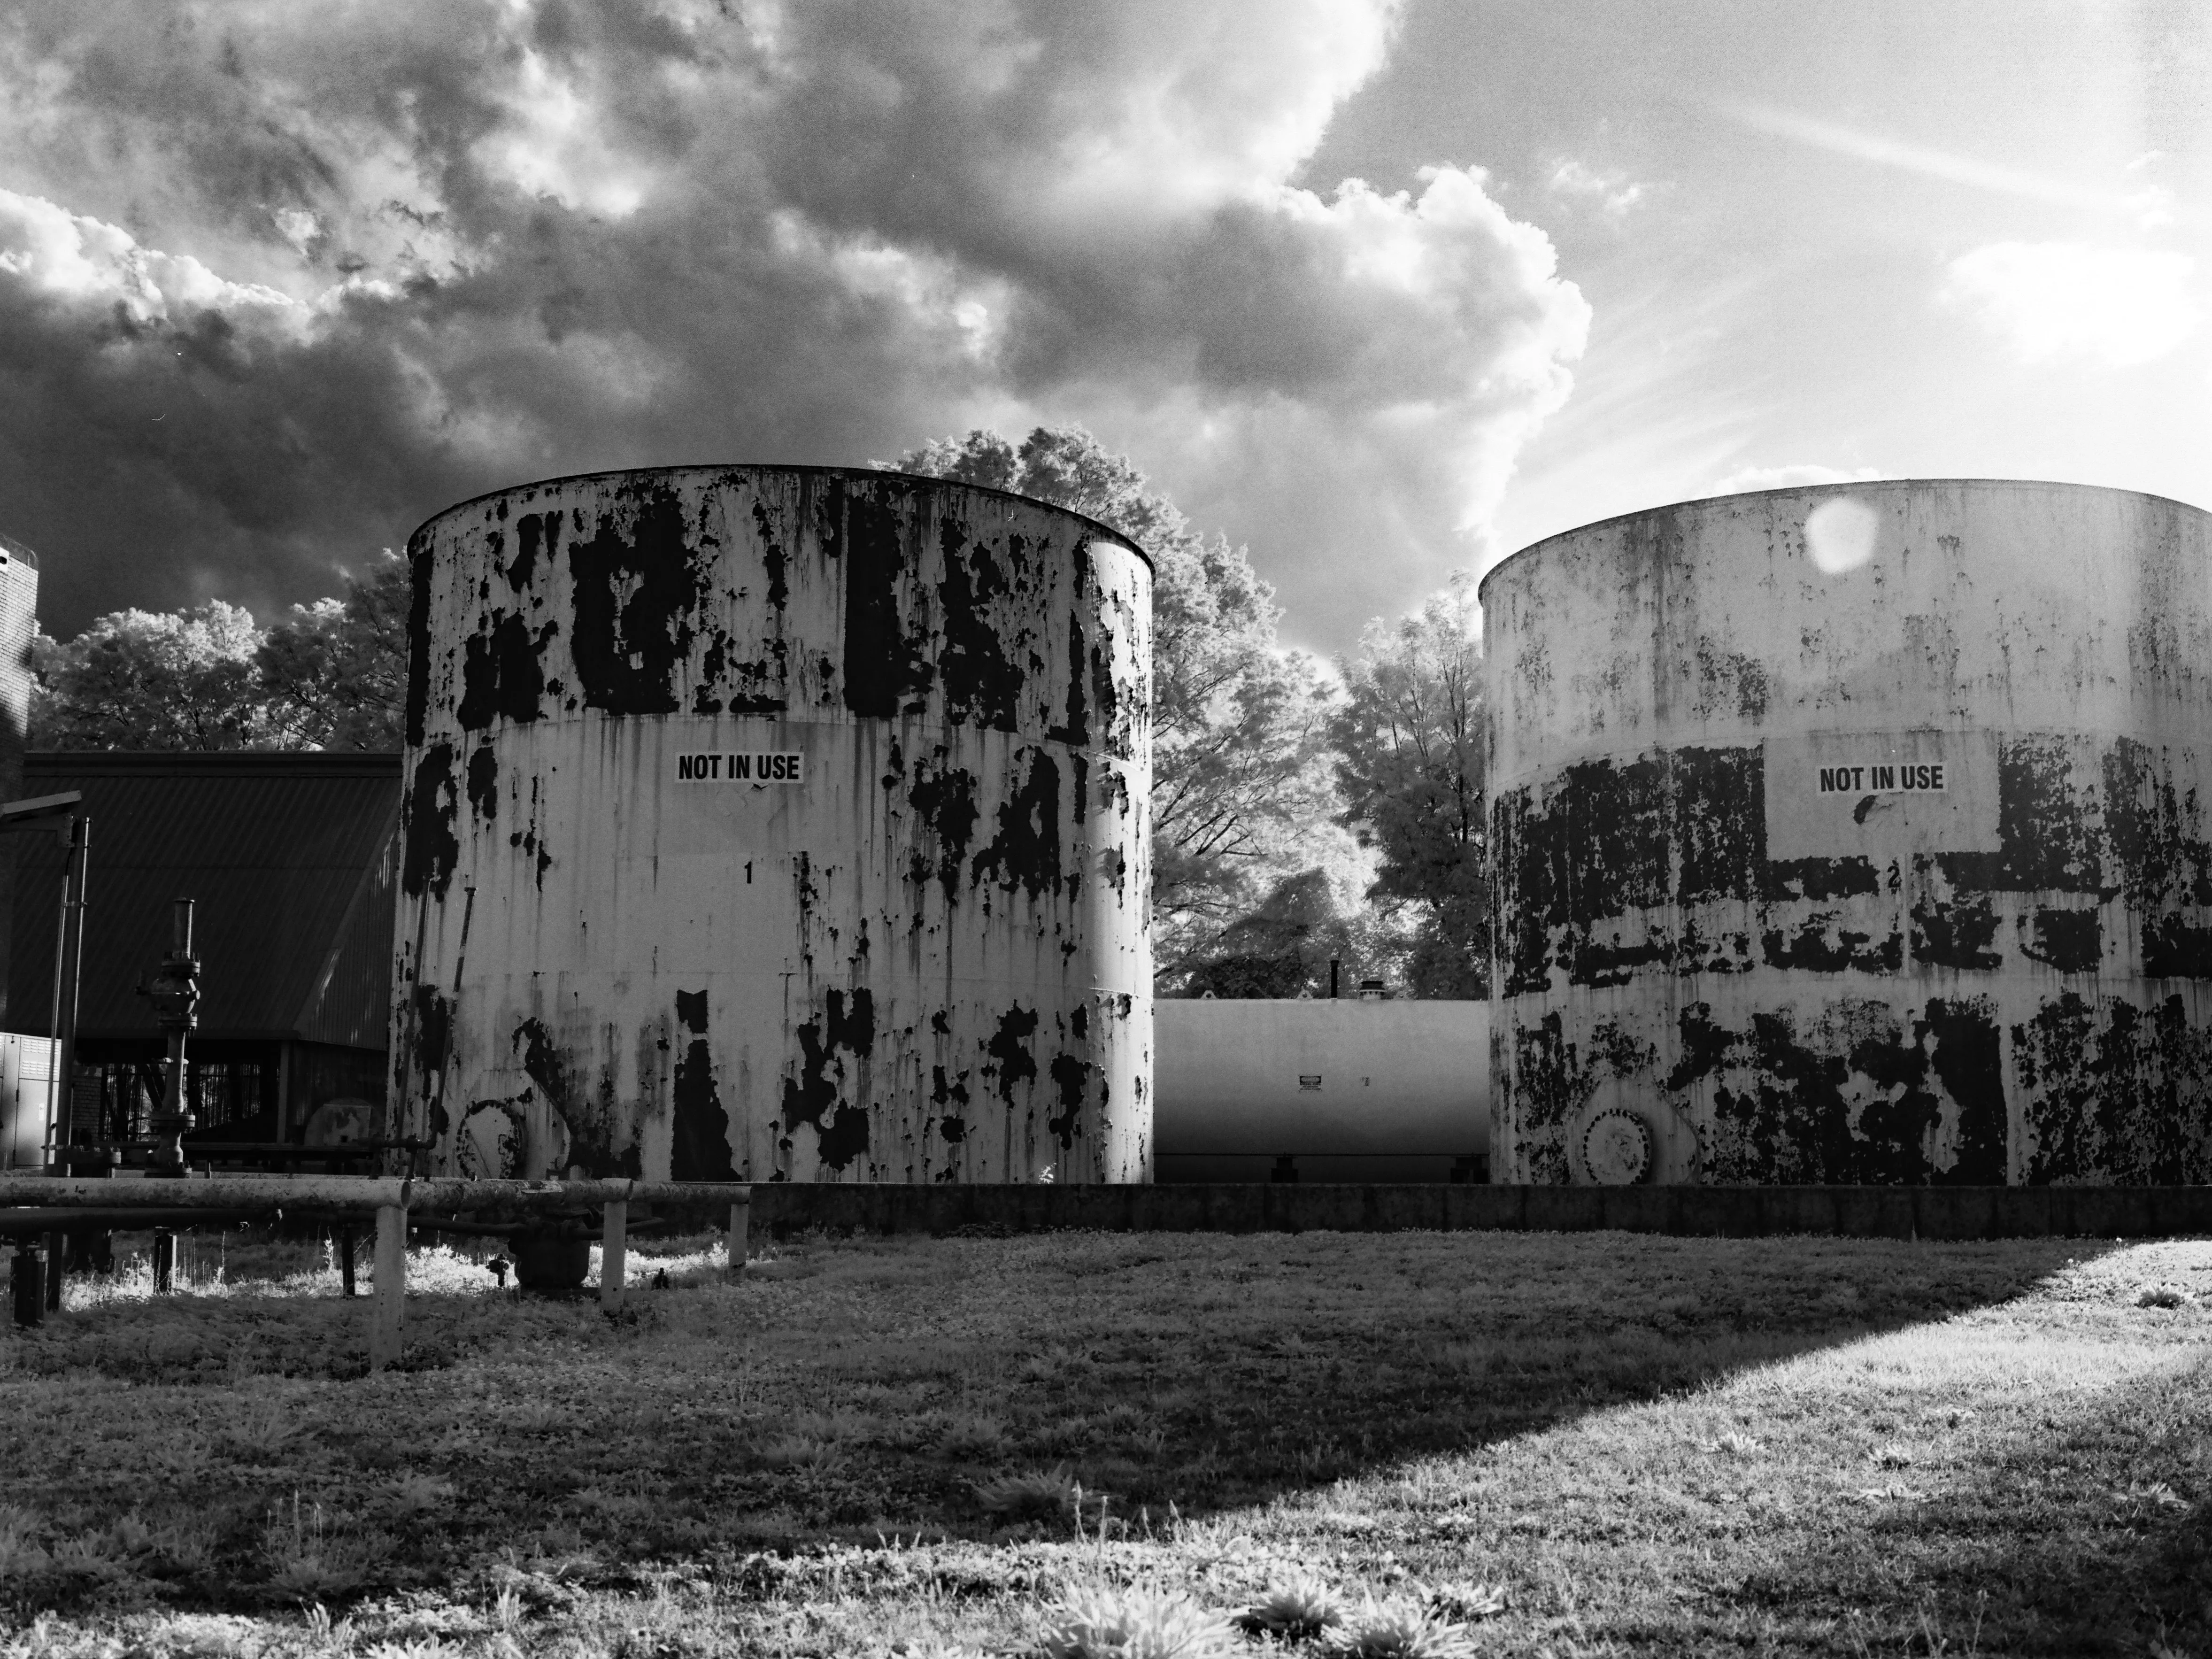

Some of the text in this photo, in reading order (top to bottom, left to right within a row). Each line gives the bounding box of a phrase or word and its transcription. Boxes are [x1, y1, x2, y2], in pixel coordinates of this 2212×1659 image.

[679, 755, 799, 780] NOT IN USE
[1820, 765, 1943, 792] NOT IN USE
[744, 861, 751, 884] 1
[1887, 866, 1901, 888] 2
